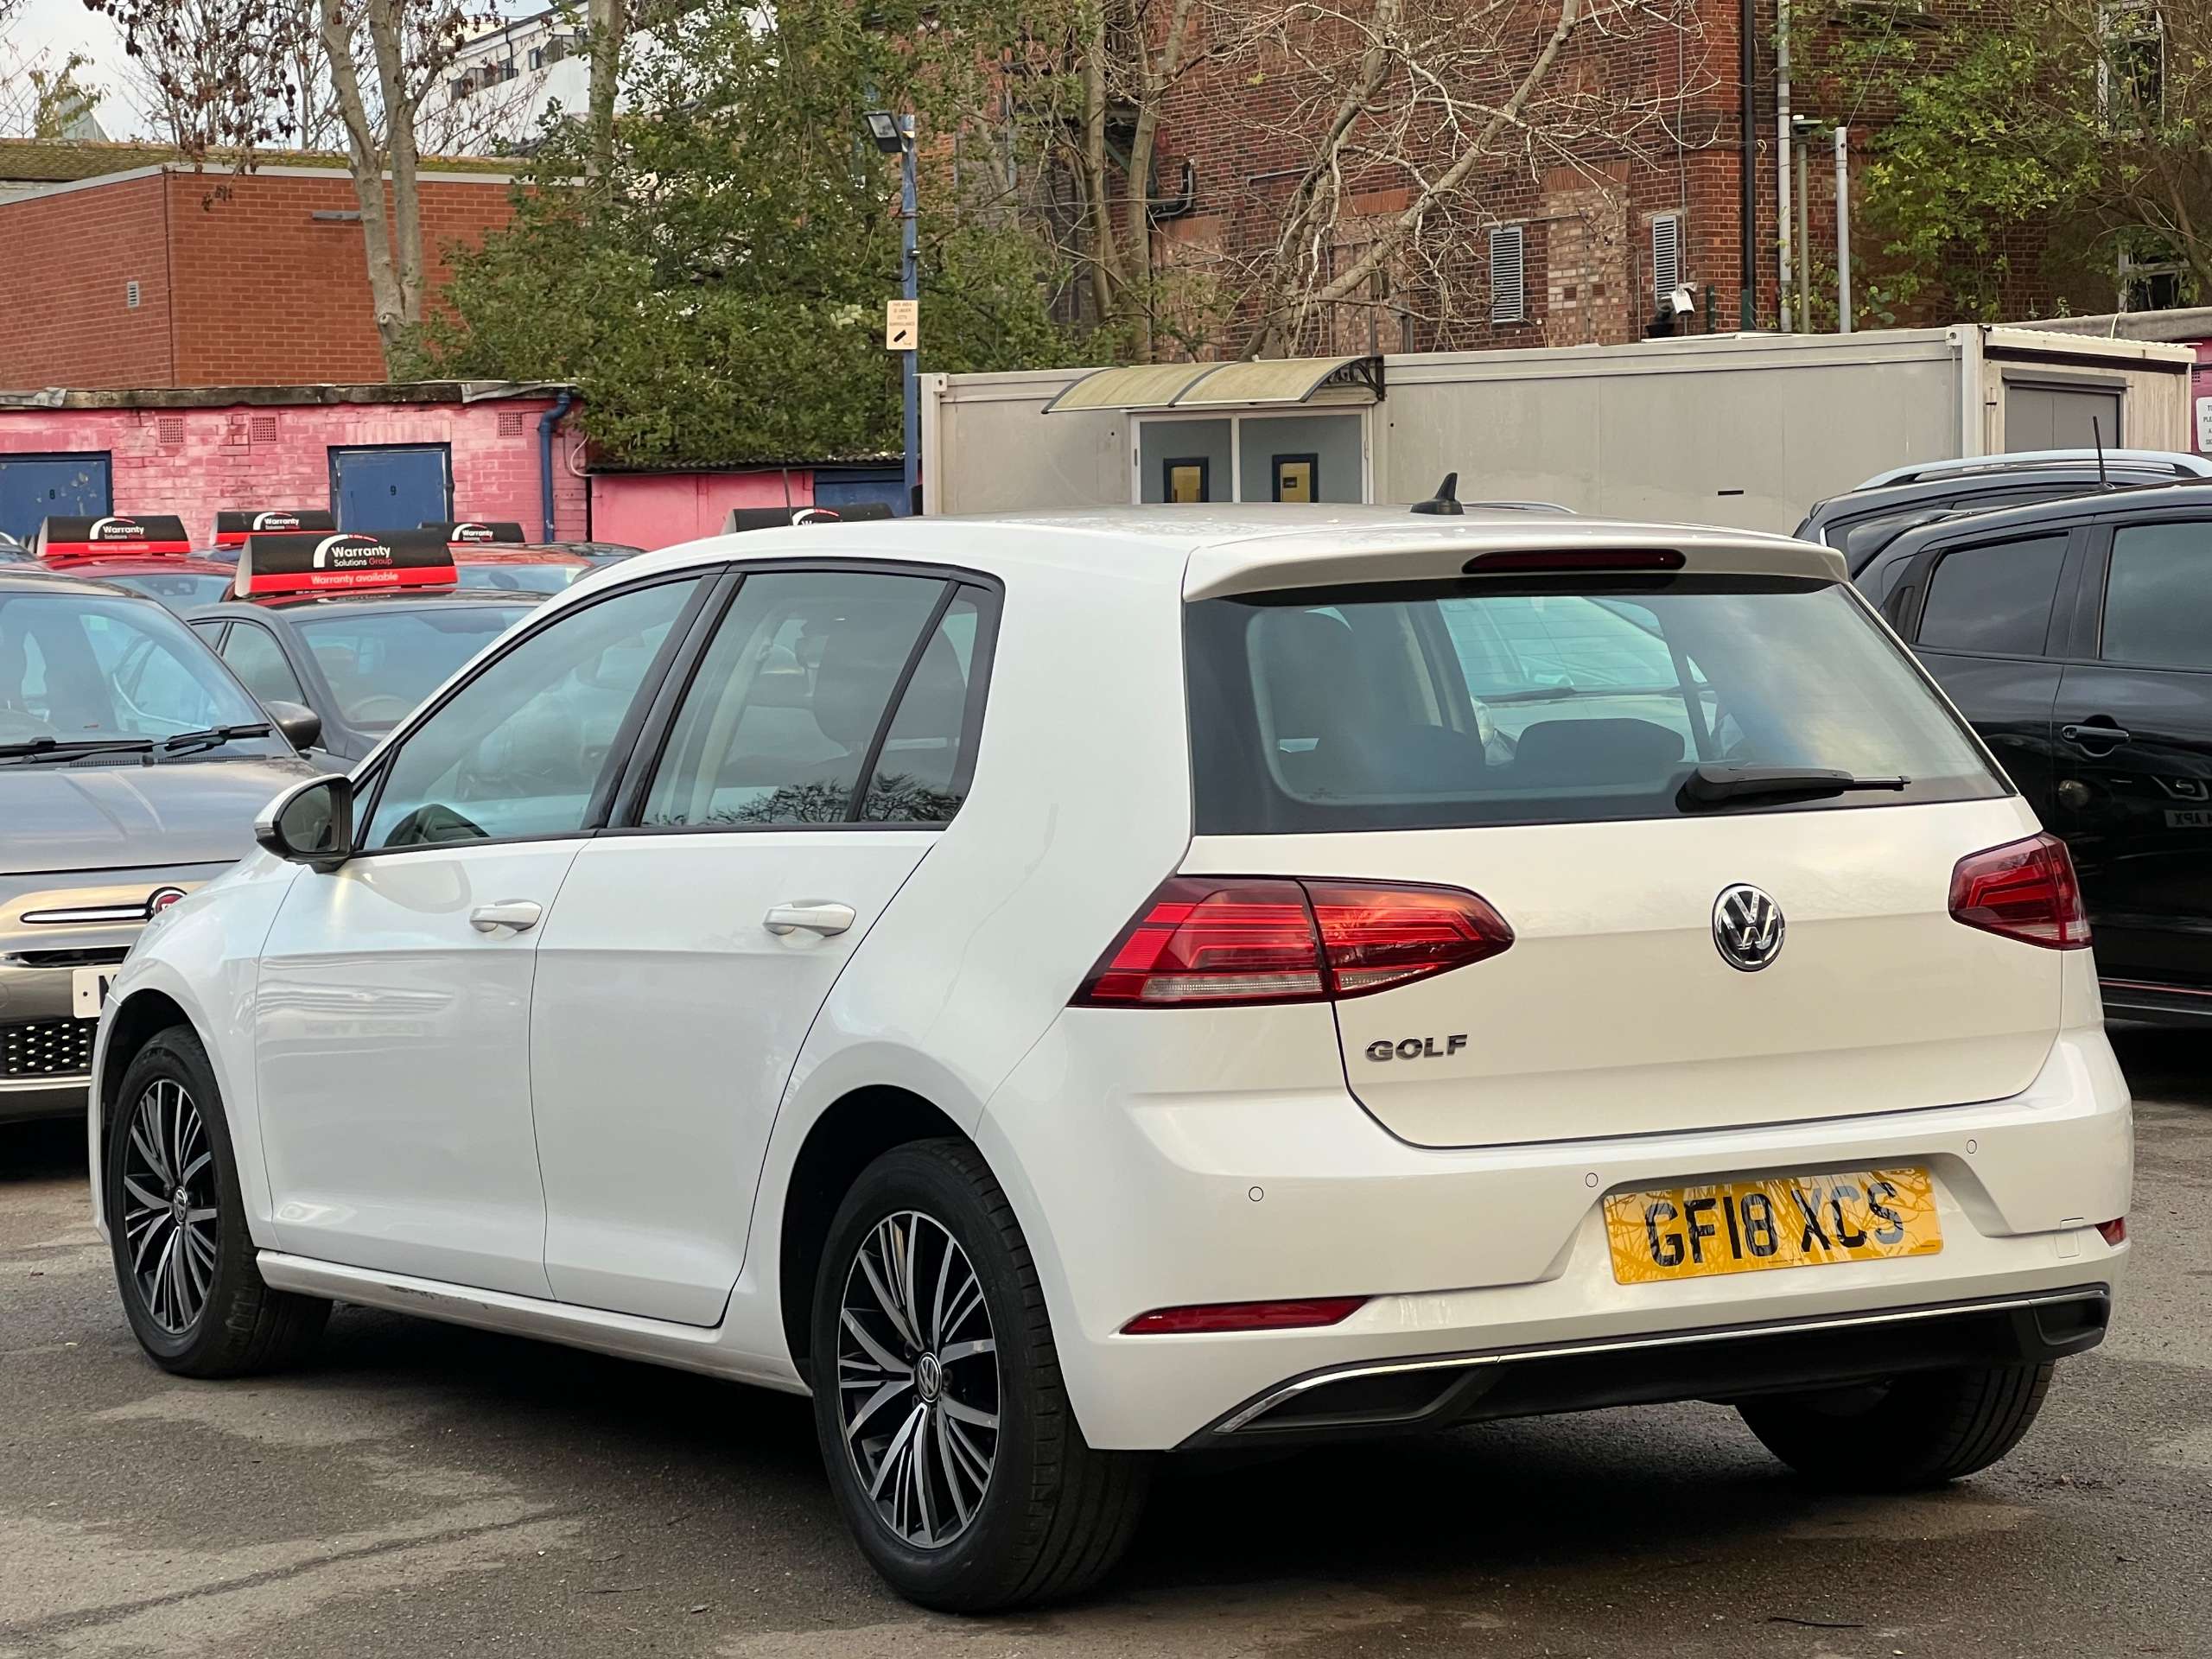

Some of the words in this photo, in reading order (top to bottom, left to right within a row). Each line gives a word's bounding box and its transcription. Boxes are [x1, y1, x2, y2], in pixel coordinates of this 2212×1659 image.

[49, 489, 56, 499] 8
[390, 485, 397, 496] 9
[102, 525, 144, 534] Warranty
[461, 529, 493, 537] Warranty
[331, 545, 391, 558] Warranty
[334, 558, 367, 567] Solutions
[368, 557, 393, 566] Group
[311, 575, 354, 585] Warranty
[355, 572, 398, 582] available
[1365, 1033, 1468, 1063] GOLF
[1644, 1192, 1780, 1267] GF18
[1790, 1181, 1904, 1254] XCS
